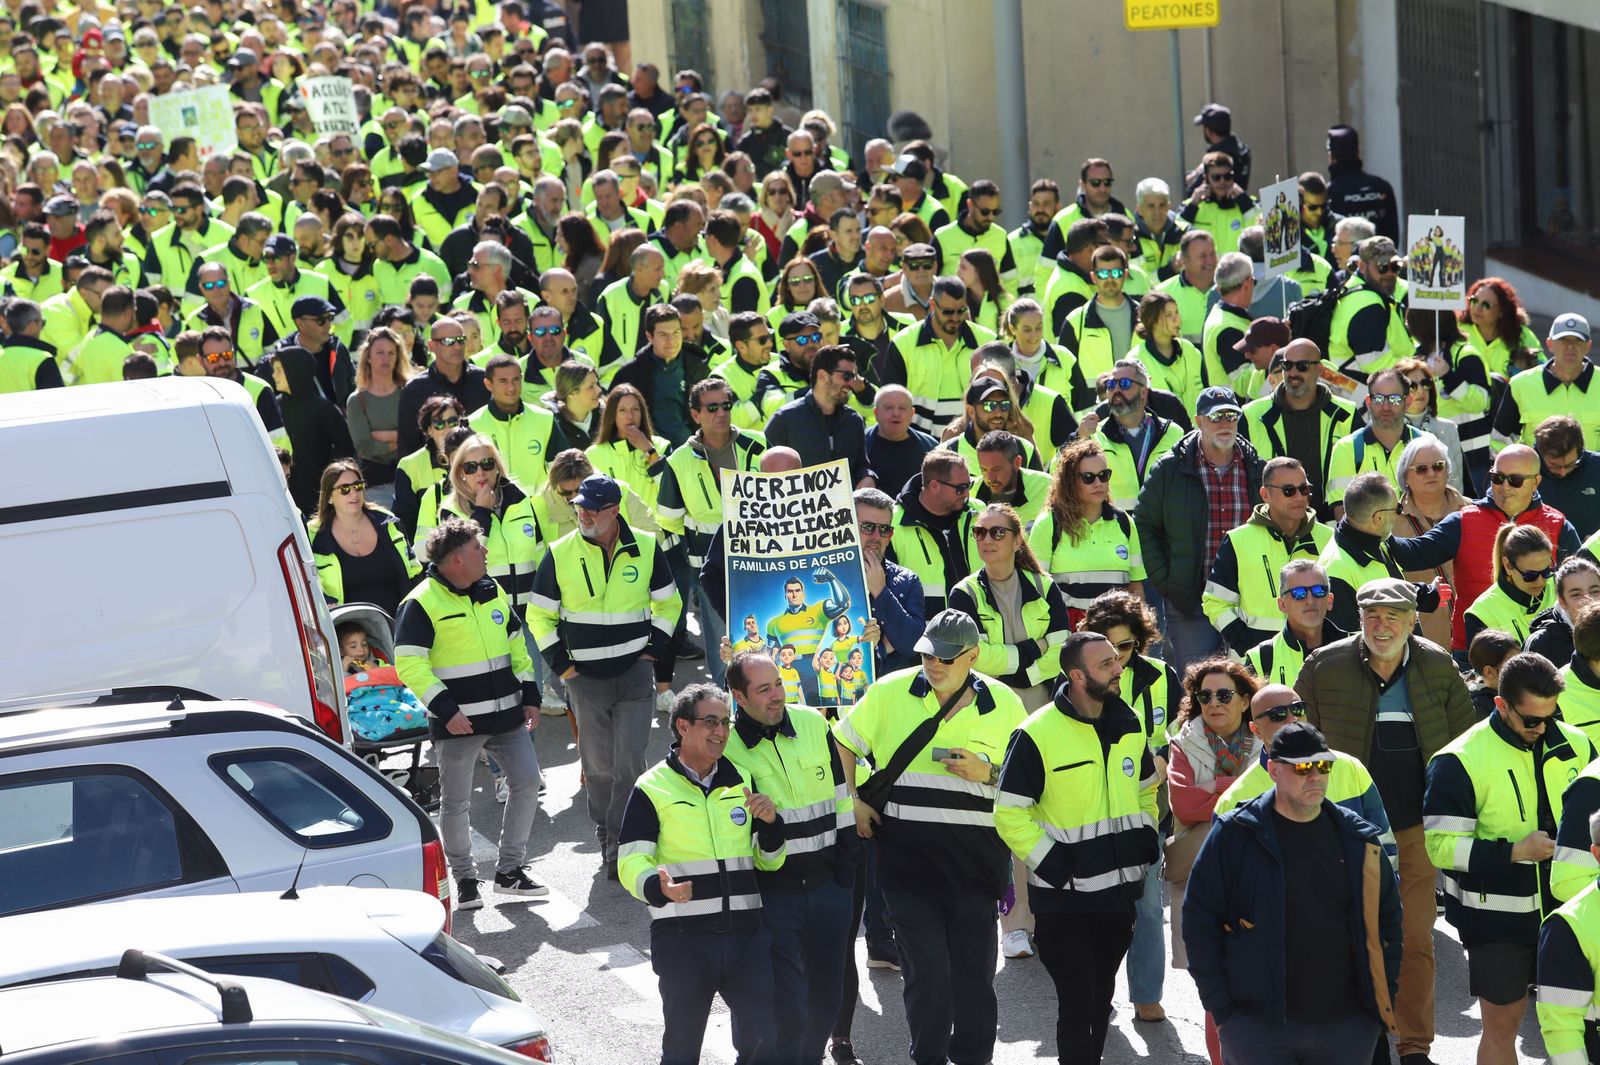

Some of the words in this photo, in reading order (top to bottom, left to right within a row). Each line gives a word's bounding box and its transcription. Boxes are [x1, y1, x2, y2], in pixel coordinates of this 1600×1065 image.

[1130, 2, 1216, 20] PEATONES
[732, 467, 842, 501] ACERINOX
[739, 493, 833, 520] ESCUCHA
[730, 539, 750, 554] EN
[755, 538, 783, 554] LA
[792, 527, 856, 551] LUCHA
[732, 560, 786, 572] FAMILIAS
[789, 558, 808, 570] DE
[811, 550, 855, 566] ACERO
